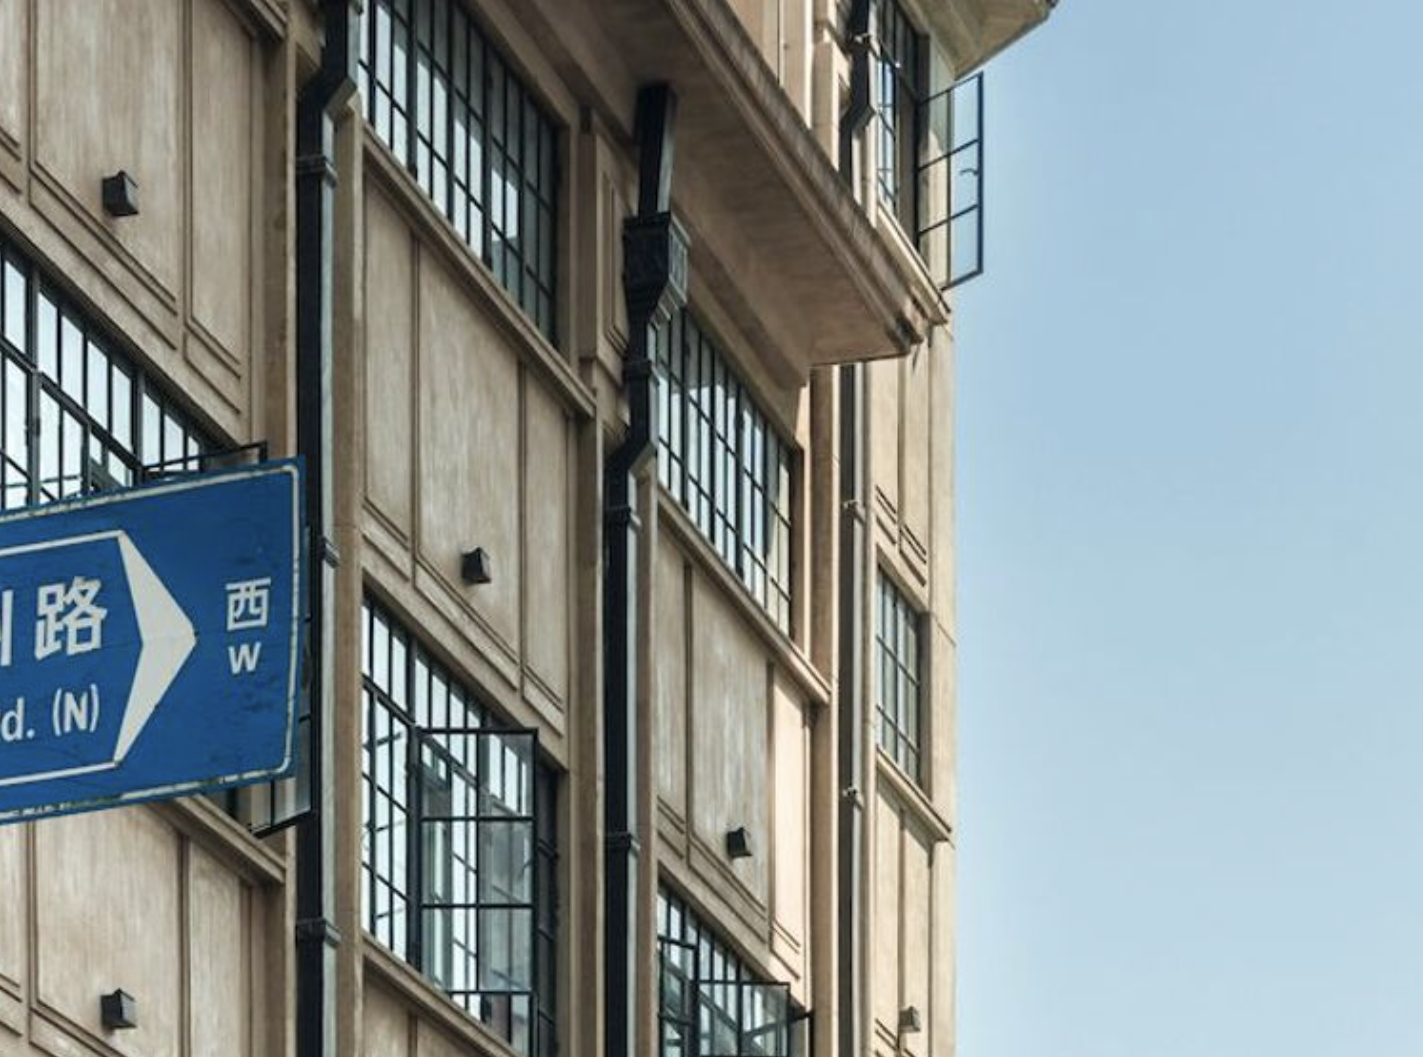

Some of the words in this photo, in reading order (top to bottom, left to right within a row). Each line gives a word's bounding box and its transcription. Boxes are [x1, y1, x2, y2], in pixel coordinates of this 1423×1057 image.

[225, 577, 272, 633] 西
[228, 644, 262, 676] W
[51, 684, 100, 737] (N)
